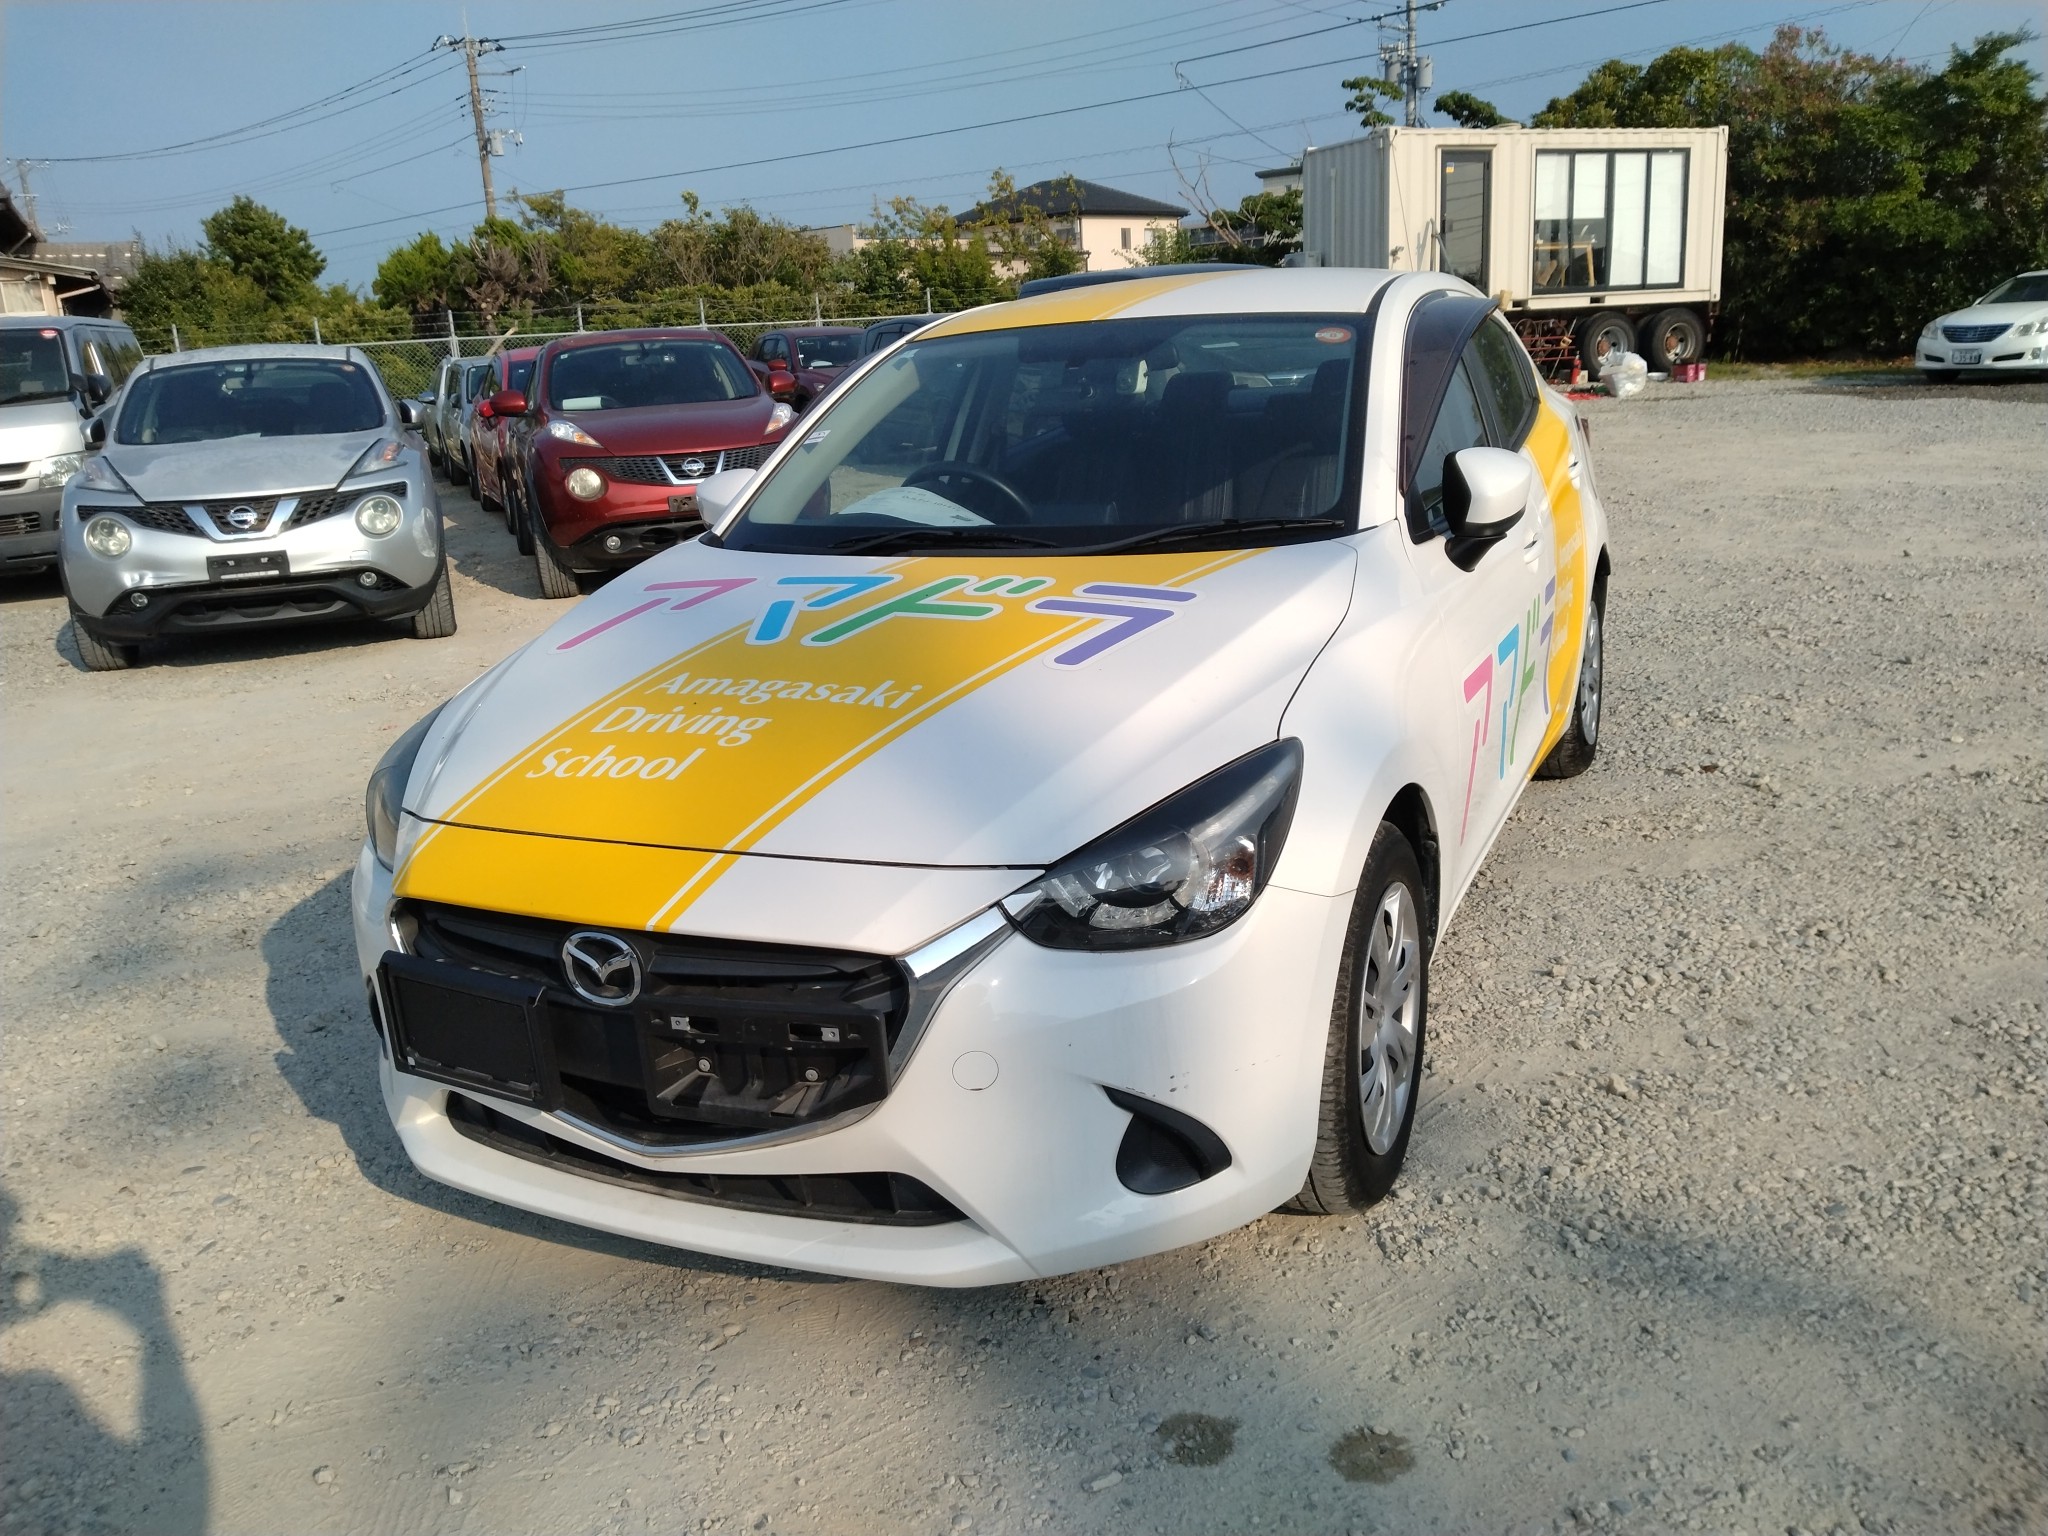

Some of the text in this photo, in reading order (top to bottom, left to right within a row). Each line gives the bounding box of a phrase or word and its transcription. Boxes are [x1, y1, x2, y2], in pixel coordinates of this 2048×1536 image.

[556, 576, 1198, 666] アマドラ
[644, 672, 923, 710] Amagasaki
[590, 705, 773, 747] Driving
[526, 745, 706, 781] School
